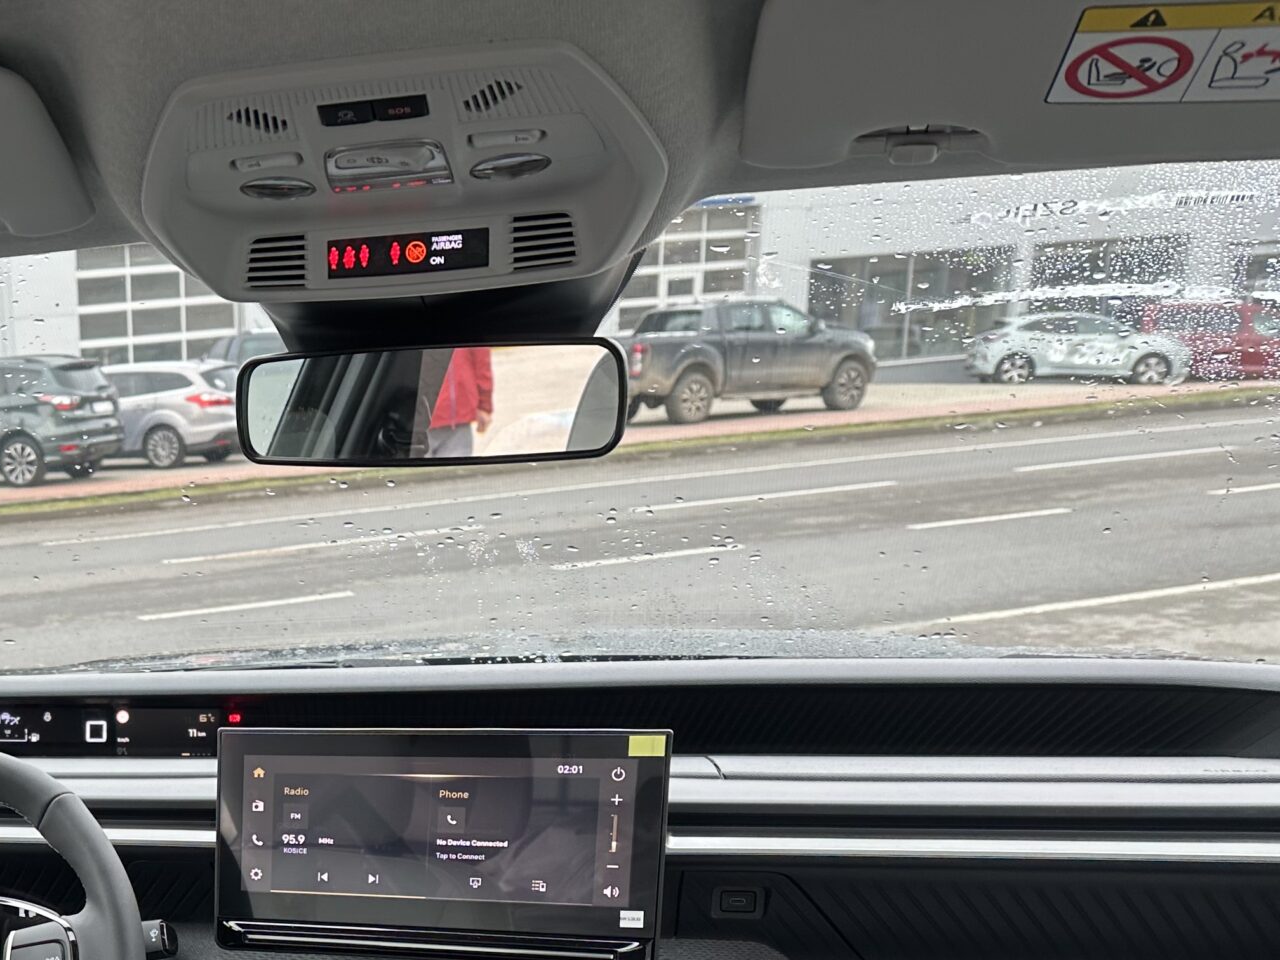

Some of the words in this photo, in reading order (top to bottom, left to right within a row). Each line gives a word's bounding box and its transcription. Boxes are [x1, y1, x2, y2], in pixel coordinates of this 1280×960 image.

[1251, 4, 1280, 23] A
[387, 106, 412, 116] SOS
[431, 234, 463, 242] PASSENGER
[431, 241, 463, 250] AIRBAG
[429, 255, 445, 265] ON
[557, 765, 583, 774] 02:01
[284, 786, 309, 796] Radio
[439, 789, 469, 799] Phone
[290, 812, 302, 820] FM
[282, 834, 306, 845] 95.9
[436, 838, 447, 846] No
[447, 839, 471, 847] Device
[471, 840, 508, 848] Connected
[283, 847, 308, 855] KOSICE
[436, 852, 448, 860] Tap
